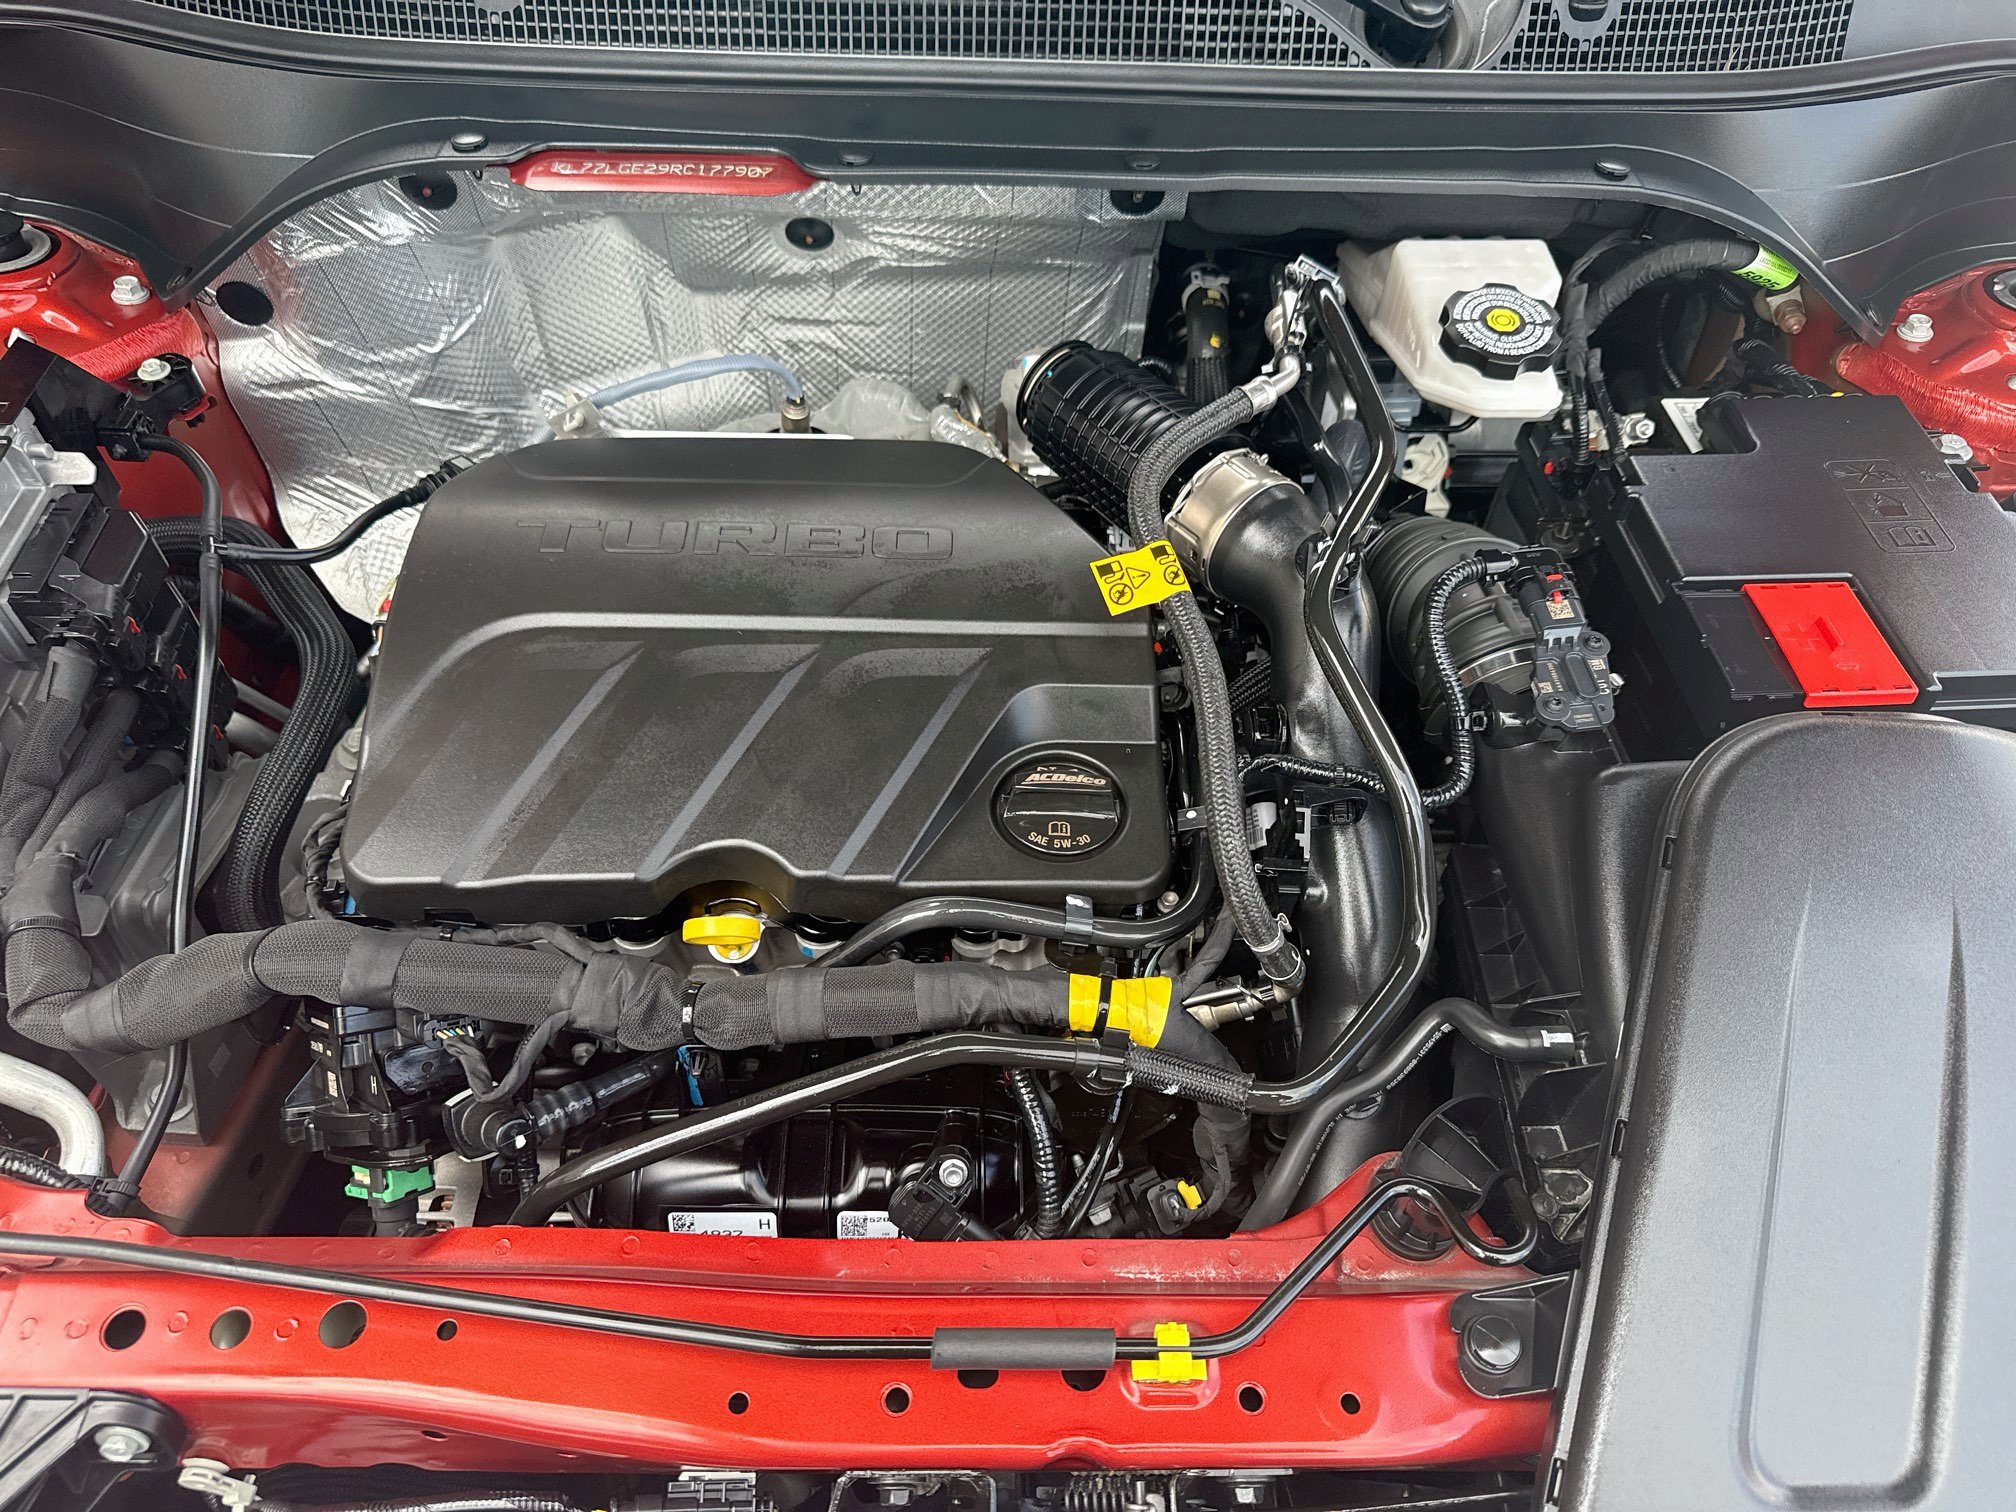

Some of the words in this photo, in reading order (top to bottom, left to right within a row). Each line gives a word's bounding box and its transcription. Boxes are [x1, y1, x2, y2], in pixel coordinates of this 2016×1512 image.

[517, 520, 953, 560] TURBO
[1025, 773, 1107, 786] ACDelco
[1027, 831, 1049, 846] SAE
[1053, 834, 1091, 848] 5W-30
[759, 1219, 771, 1230] H
